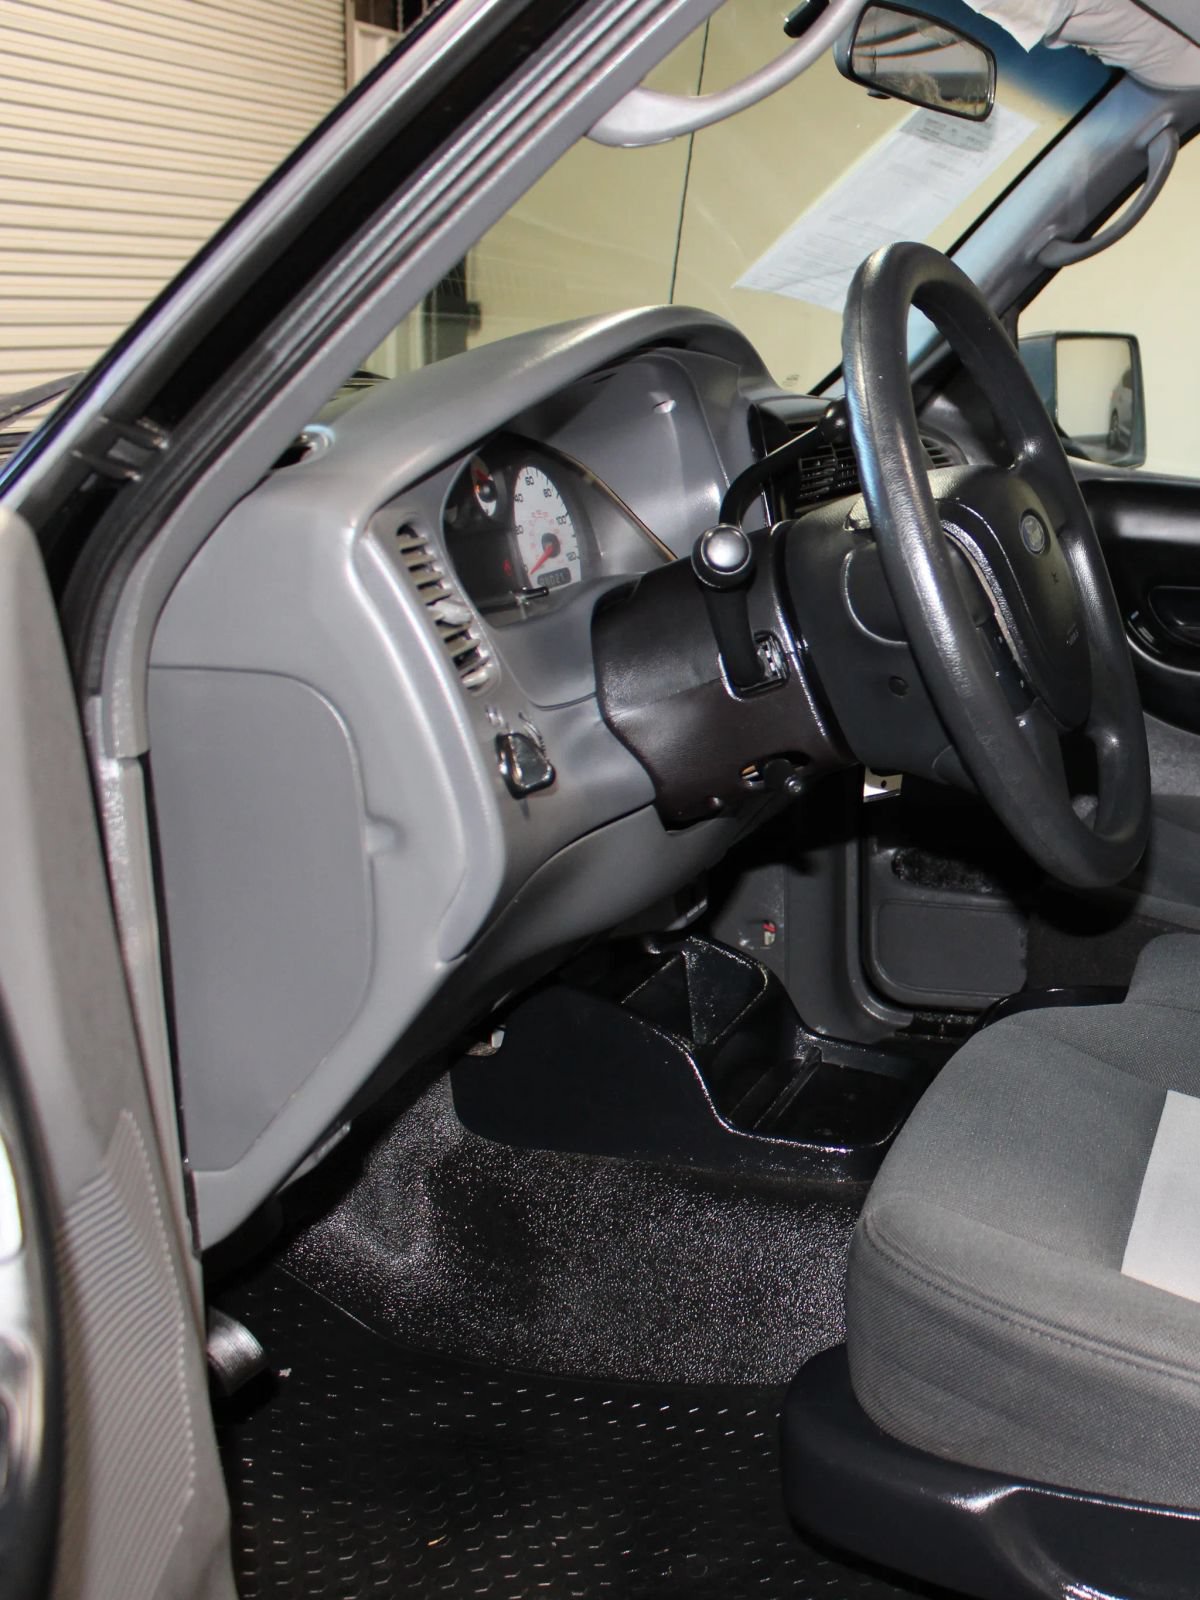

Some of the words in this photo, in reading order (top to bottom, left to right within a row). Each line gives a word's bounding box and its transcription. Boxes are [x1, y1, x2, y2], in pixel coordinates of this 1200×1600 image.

[525, 475, 534, 486] 60
[514, 493, 524, 503] 40
[543, 488, 552, 498] 80
[556, 515, 567, 525] 100
[566, 551, 577, 562] 120
